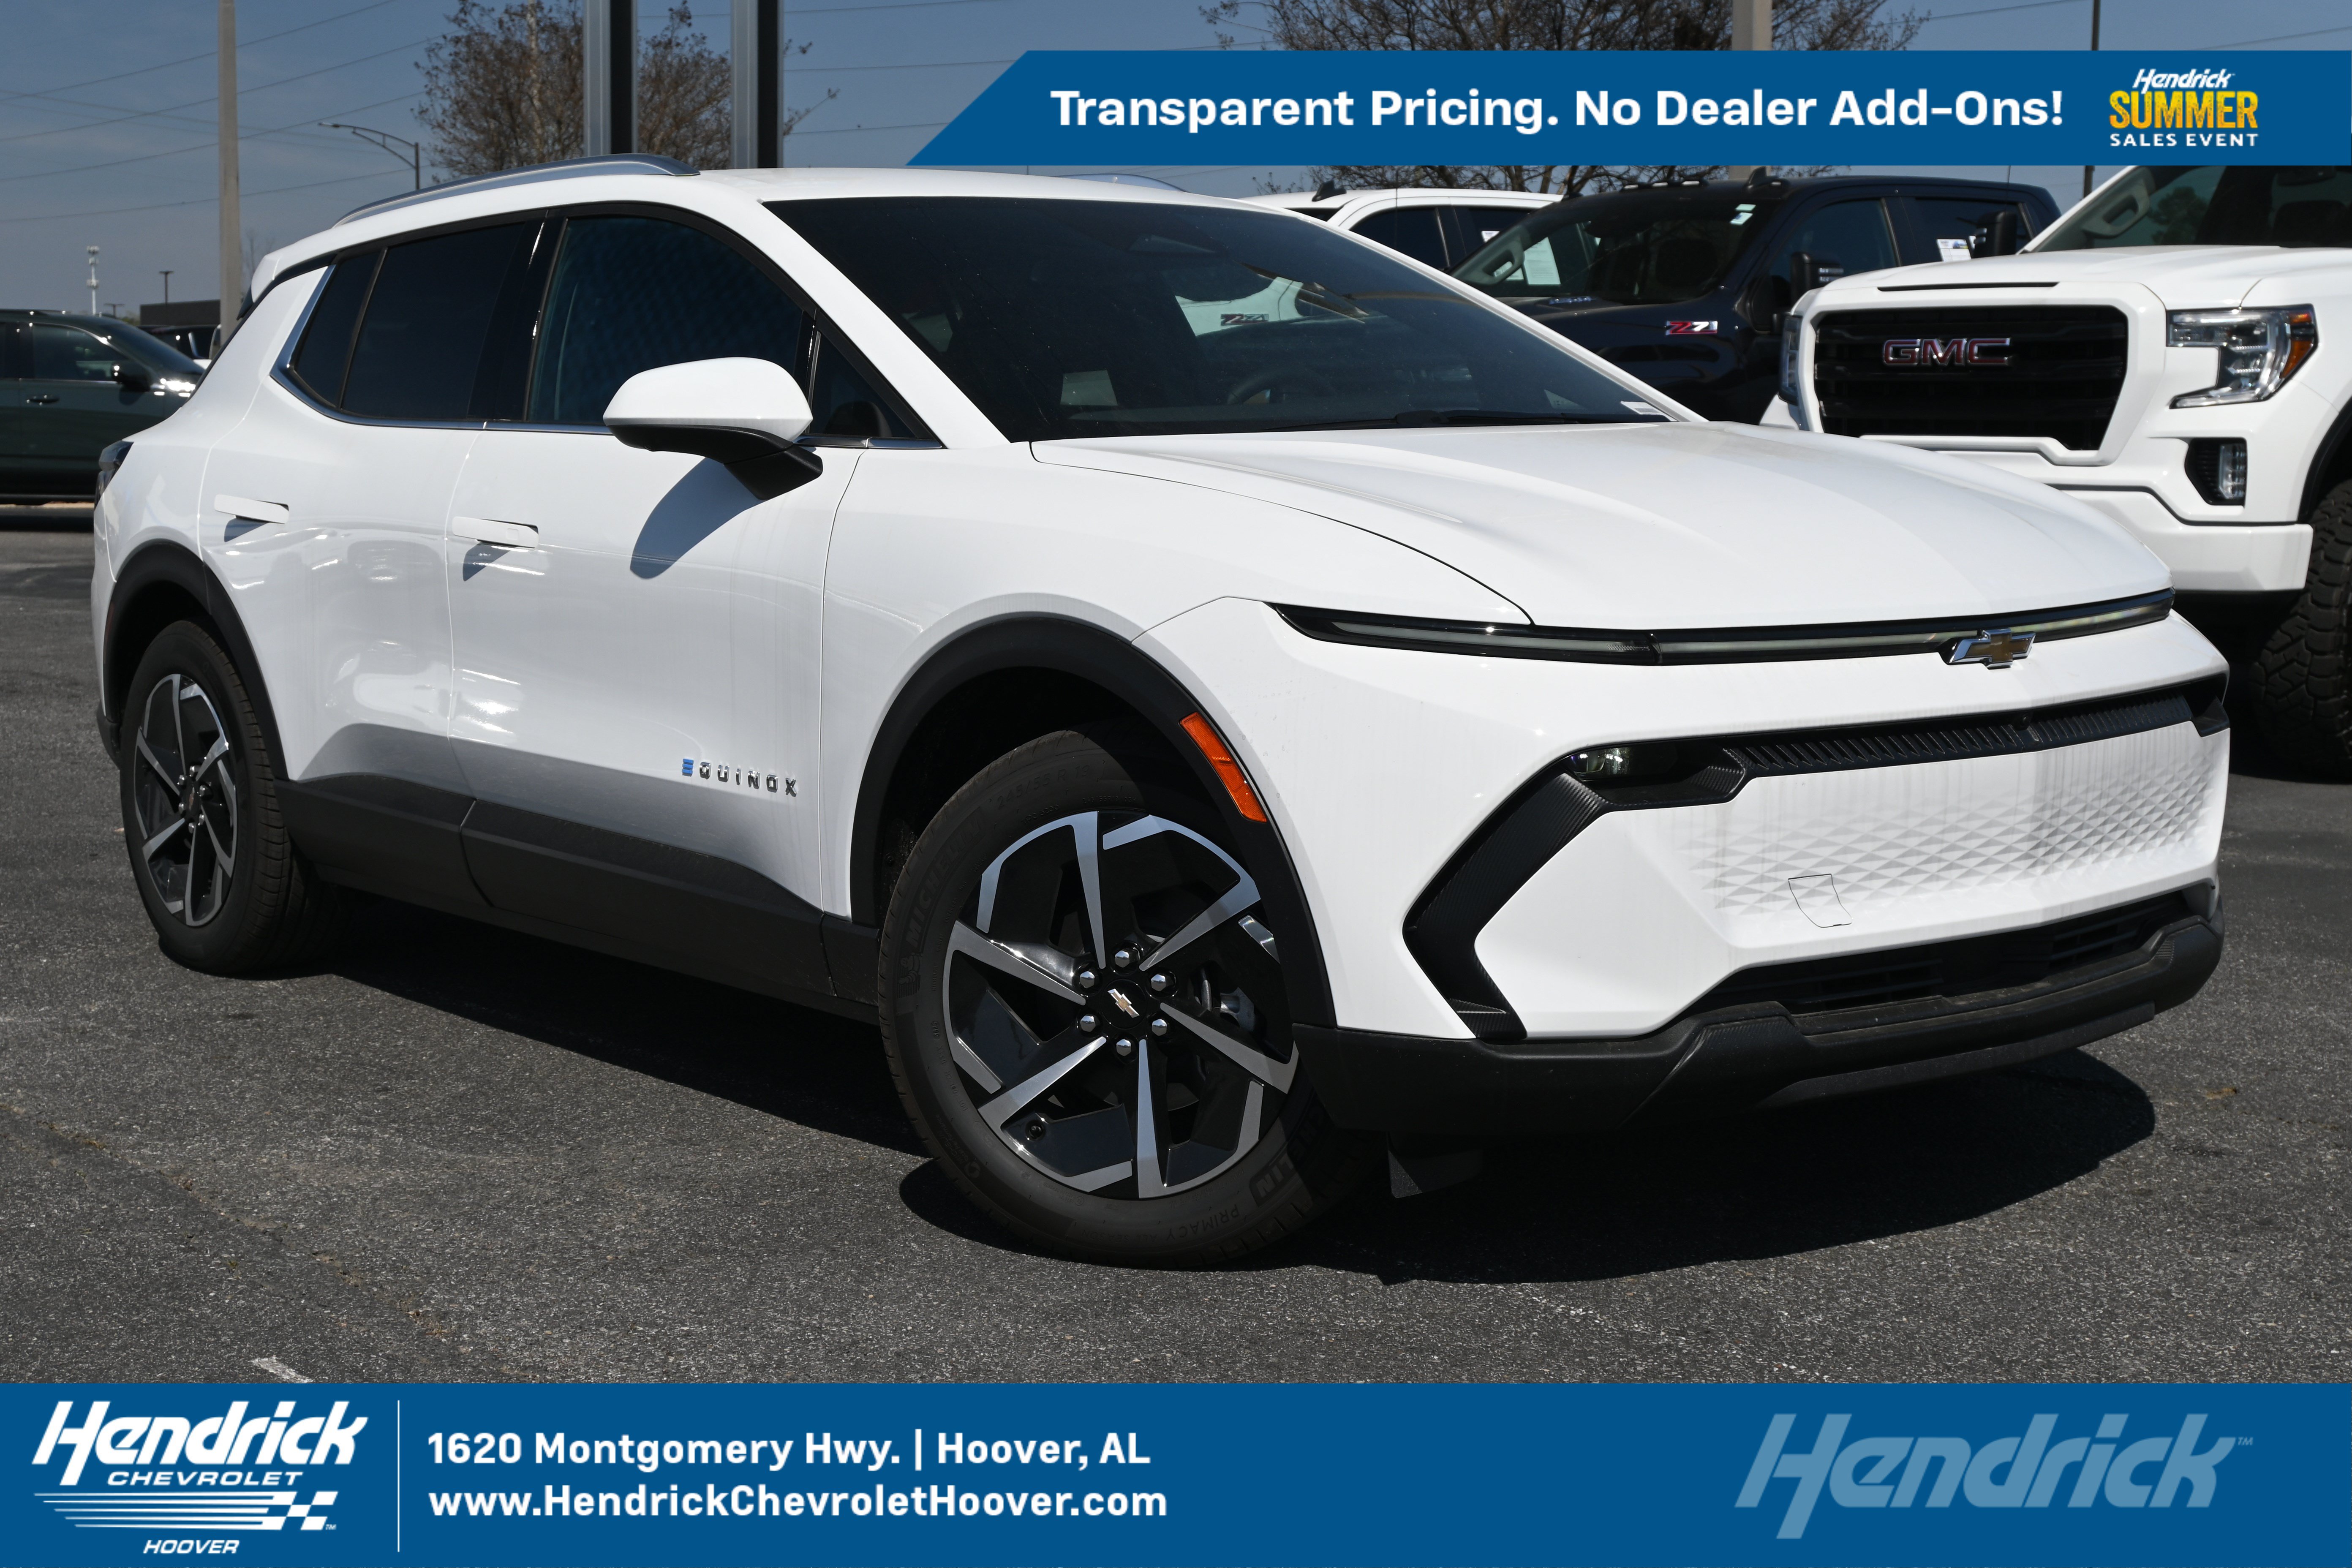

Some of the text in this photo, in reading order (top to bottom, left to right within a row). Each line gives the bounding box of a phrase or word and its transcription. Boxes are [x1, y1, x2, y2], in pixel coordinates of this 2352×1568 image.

[1666, 321, 1718, 335] Z71
[1884, 338, 2010, 366] GMC
[681, 759, 797, 797] EQUINOX
[997, 765, 1090, 810] 245/55 R 19
[906, 817, 981, 948] MICHELIN
[1081, 1229, 1130, 1244] SEASON
[1165, 1204, 1240, 1241] PRIMACY
